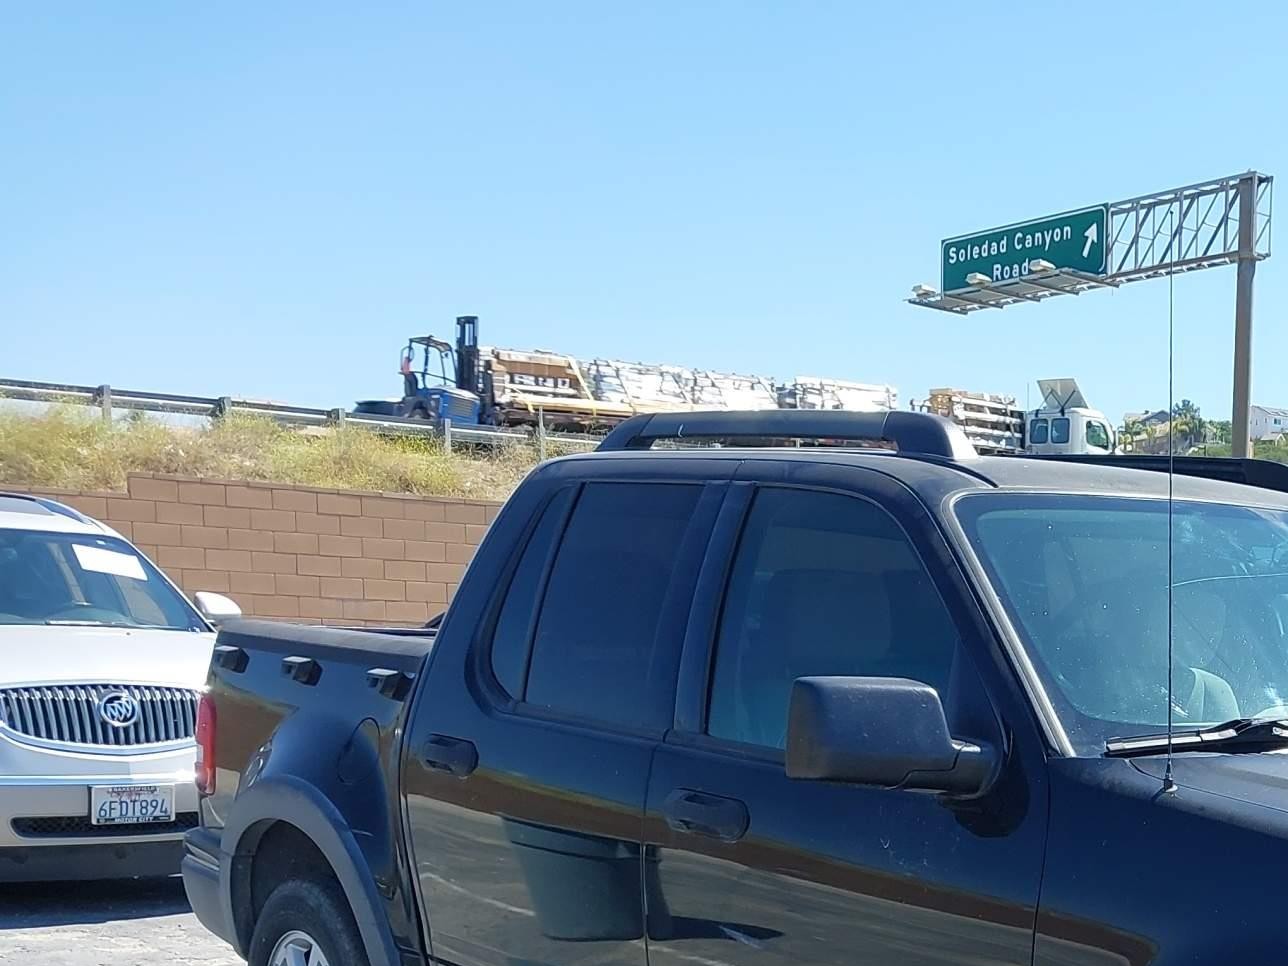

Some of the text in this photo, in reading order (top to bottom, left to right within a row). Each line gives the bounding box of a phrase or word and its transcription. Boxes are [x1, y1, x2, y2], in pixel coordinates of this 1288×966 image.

[948, 226, 1072, 264] Soledad Canyon
[992, 257, 1029, 281] Road
[98, 799, 168, 817] 6FDT894
